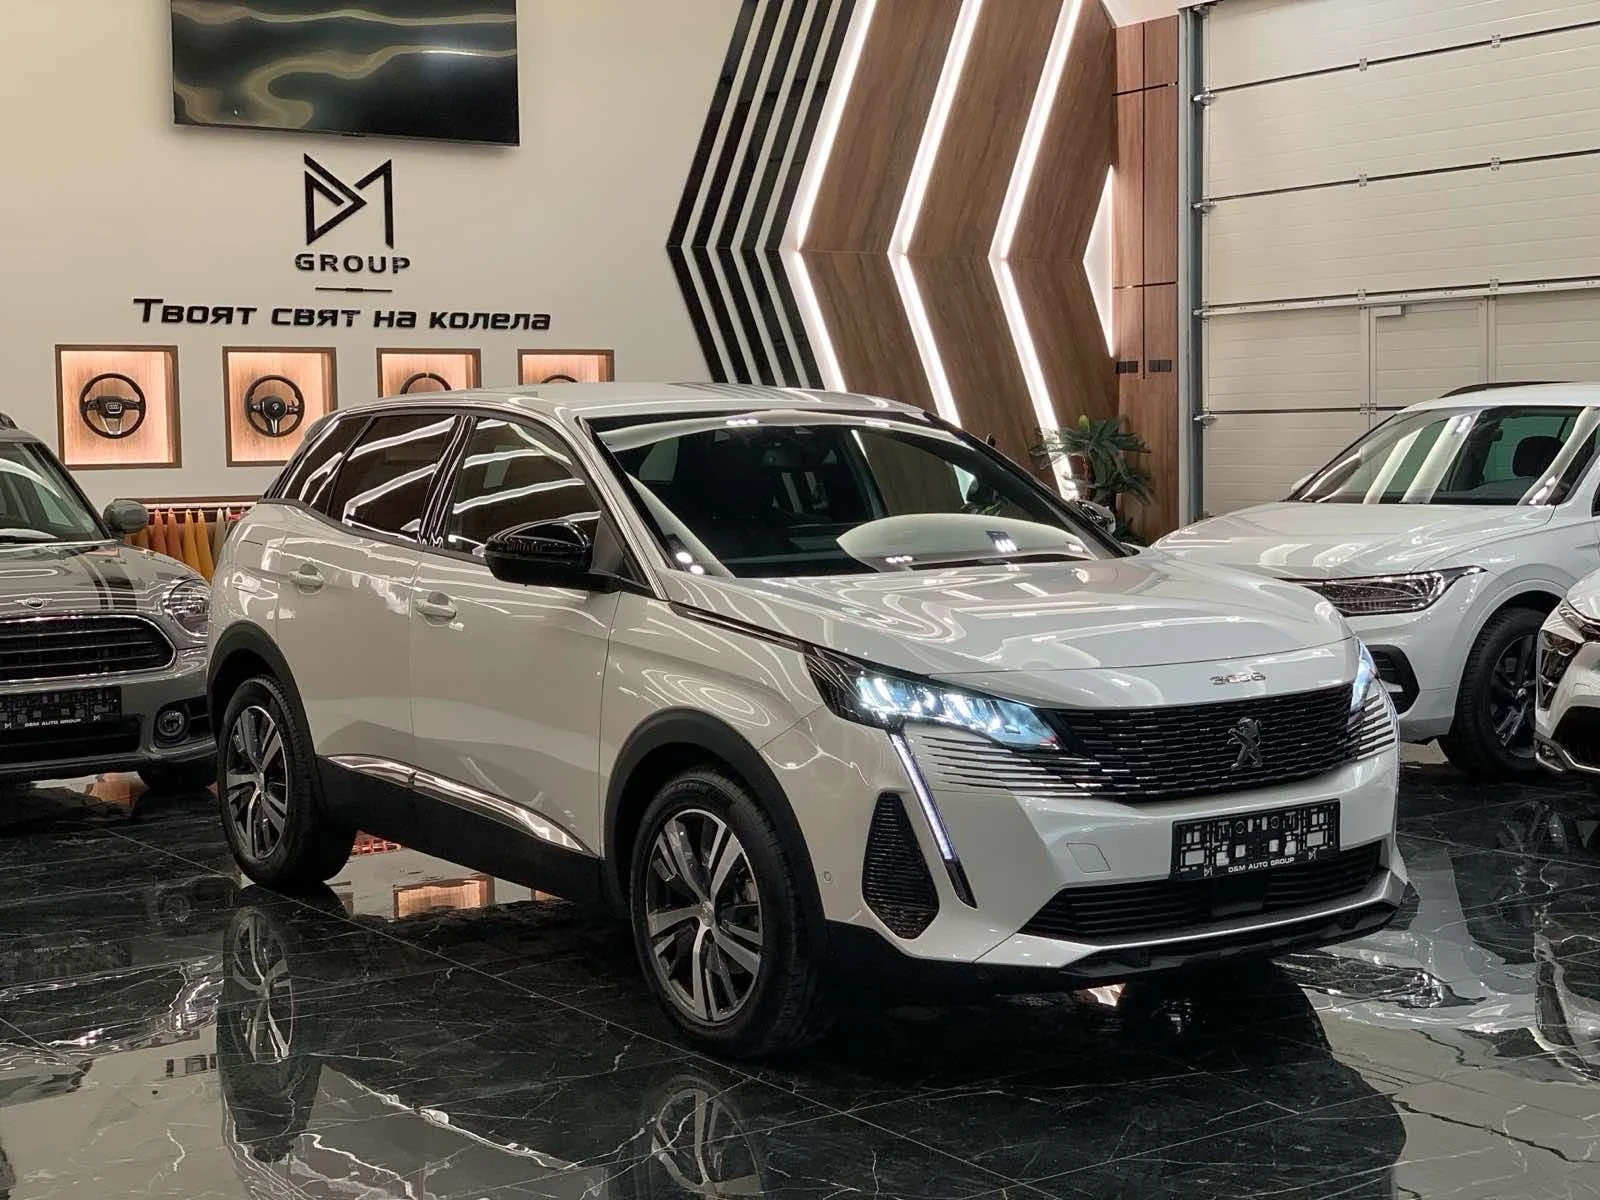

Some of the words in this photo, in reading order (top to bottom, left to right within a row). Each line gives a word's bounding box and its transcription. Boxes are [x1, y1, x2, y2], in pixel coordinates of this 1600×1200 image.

[294, 252, 411, 274] GROUP
[133, 298, 258, 325] Твоят
[271, 307, 361, 328] свят
[373, 310, 417, 329] на
[429, 311, 551, 330] колела
[1248, 861, 1268, 870] AUTO
[1271, 857, 1295, 867] GROUP
